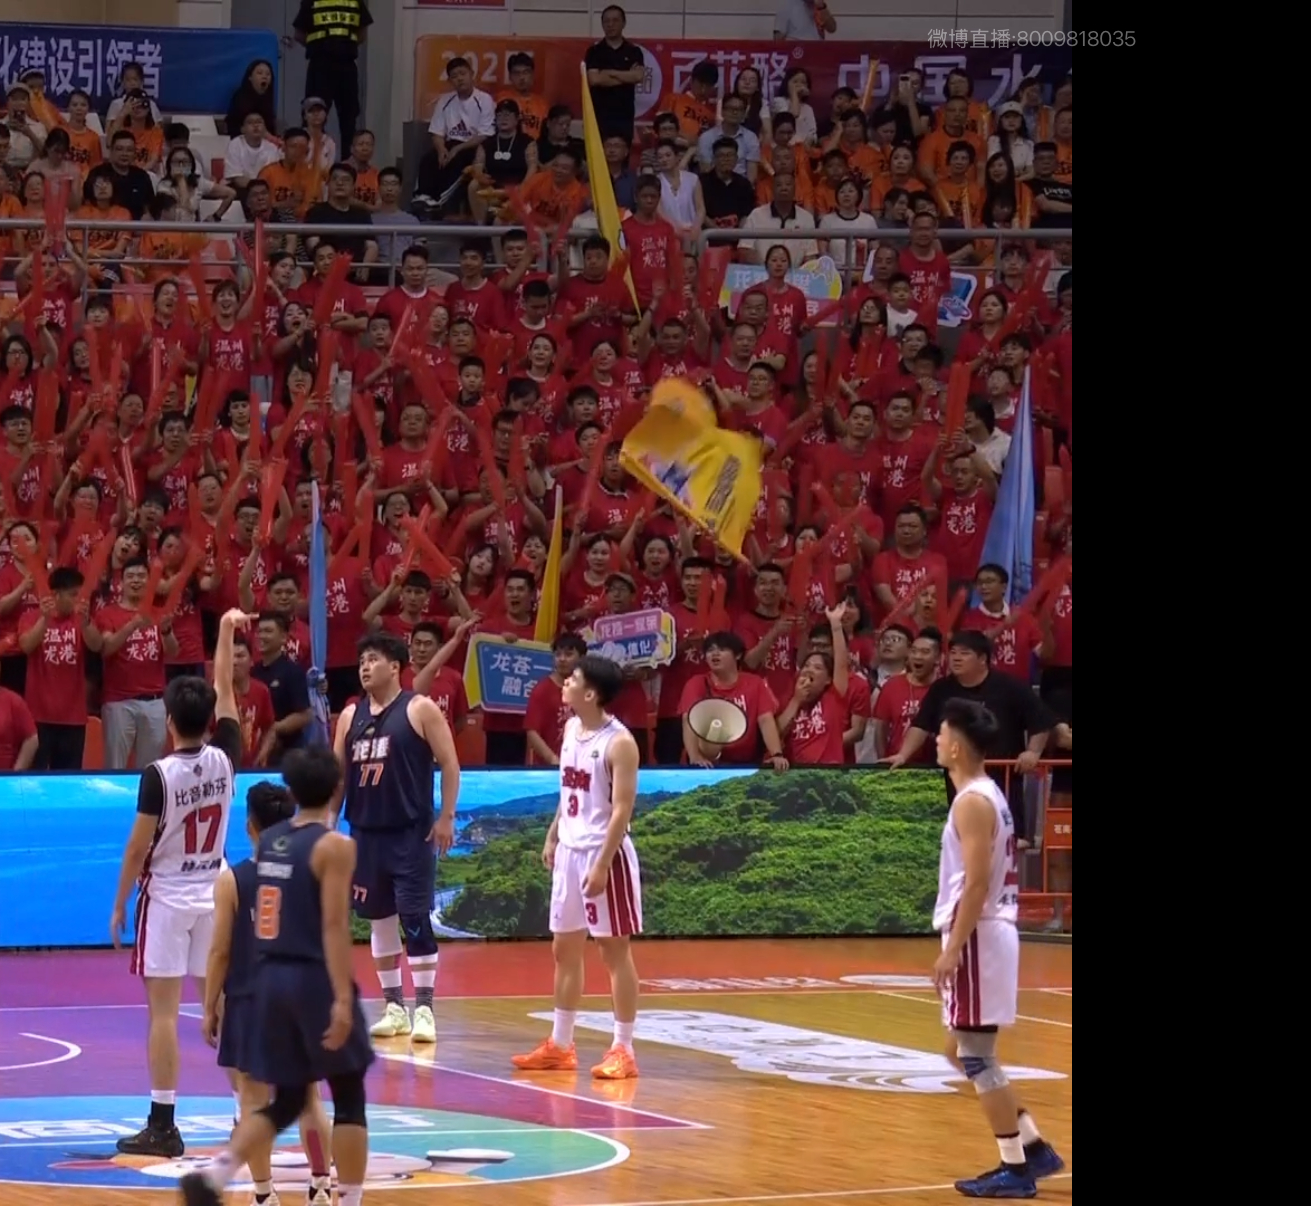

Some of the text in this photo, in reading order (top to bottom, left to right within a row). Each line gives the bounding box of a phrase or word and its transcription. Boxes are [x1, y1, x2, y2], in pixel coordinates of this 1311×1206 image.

[838, 54, 1072, 108] 中国水
[402, 463, 417, 476] 温
[607, 509, 623, 524] 温
[329, 580, 346, 593] 州
[331, 597, 348, 615] 港
[44, 628, 76, 642] 温州
[44, 645, 77, 665] 龙港
[126, 644, 159, 661] 龙港
[358, 763, 385, 787] 77
[175, 778, 227, 807] 比音勒芬
[567, 795, 579, 818] 3
[182, 803, 222, 854] 17
[586, 903, 598, 925] 3
